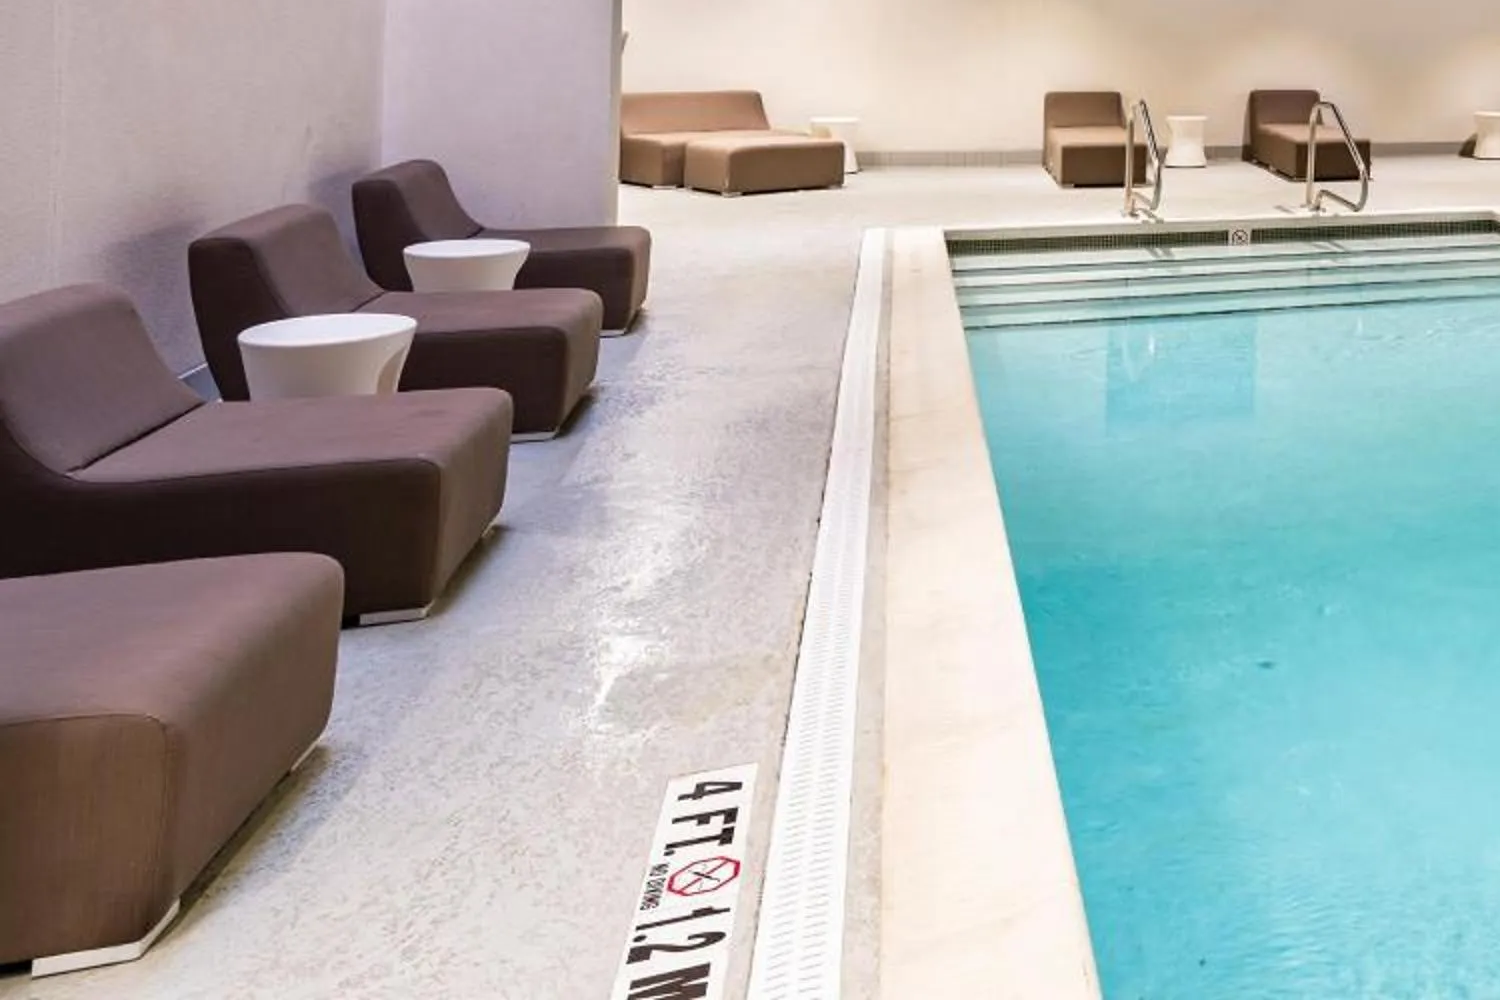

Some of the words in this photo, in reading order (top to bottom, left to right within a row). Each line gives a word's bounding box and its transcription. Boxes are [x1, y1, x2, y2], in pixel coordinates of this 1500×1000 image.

[677, 781, 743, 801] 4
[664, 807, 738, 856] FT.
[626, 905, 730, 965] 1.2
